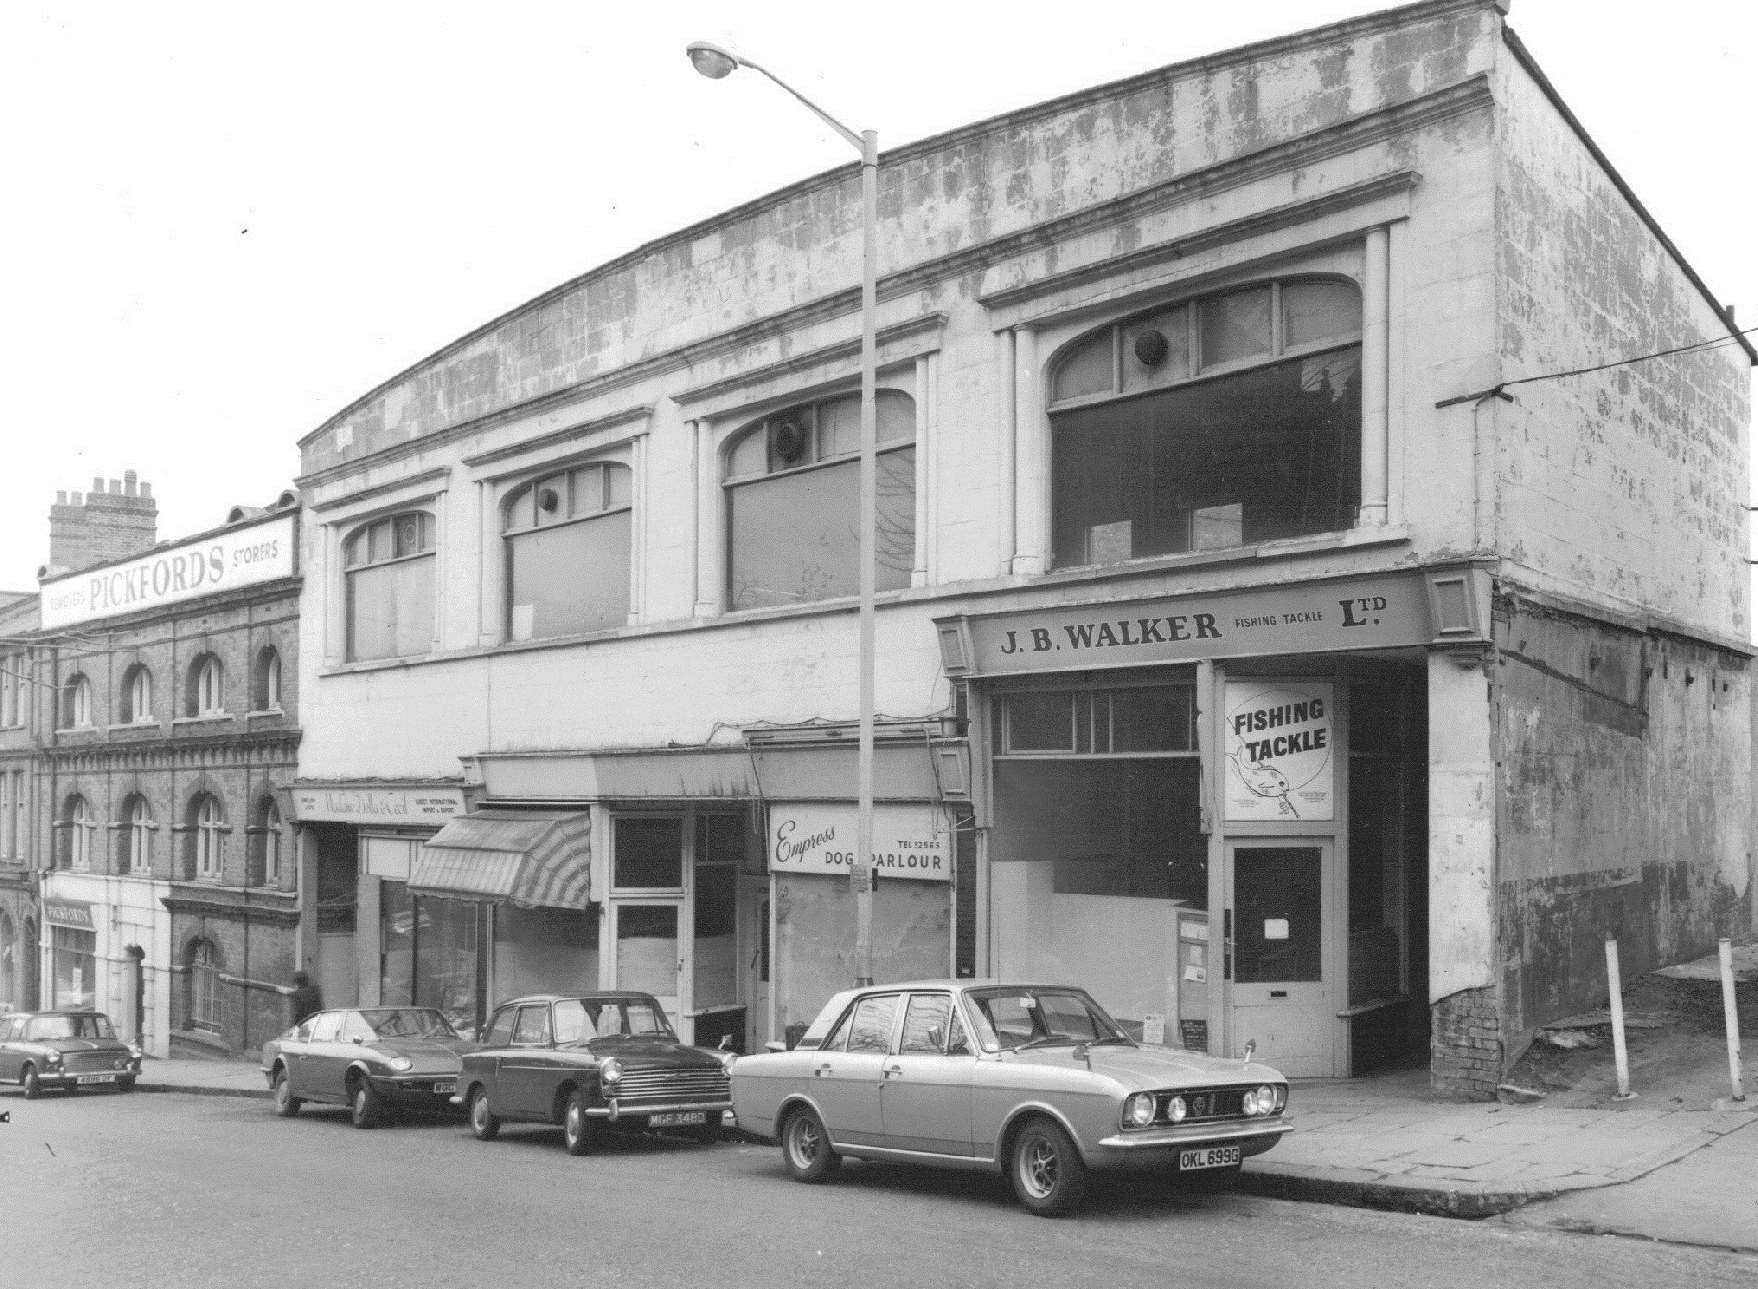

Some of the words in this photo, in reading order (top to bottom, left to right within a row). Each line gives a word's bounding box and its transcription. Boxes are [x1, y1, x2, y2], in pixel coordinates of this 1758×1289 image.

[89, 546, 226, 611] PICKFORDS
[233, 539, 279, 567] STORERS
[1063, 612, 1222, 650] WALKER
[1234, 614, 1278, 628] FISHING
[1283, 610, 1324, 626] TACKLE
[1235, 698, 1325, 736] FISHING
[1245, 728, 1327, 763] TACKLE
[775, 820, 835, 863] Empress
[825, 852, 854, 865] DOG
[1182, 1152, 1206, 1168] OKL
